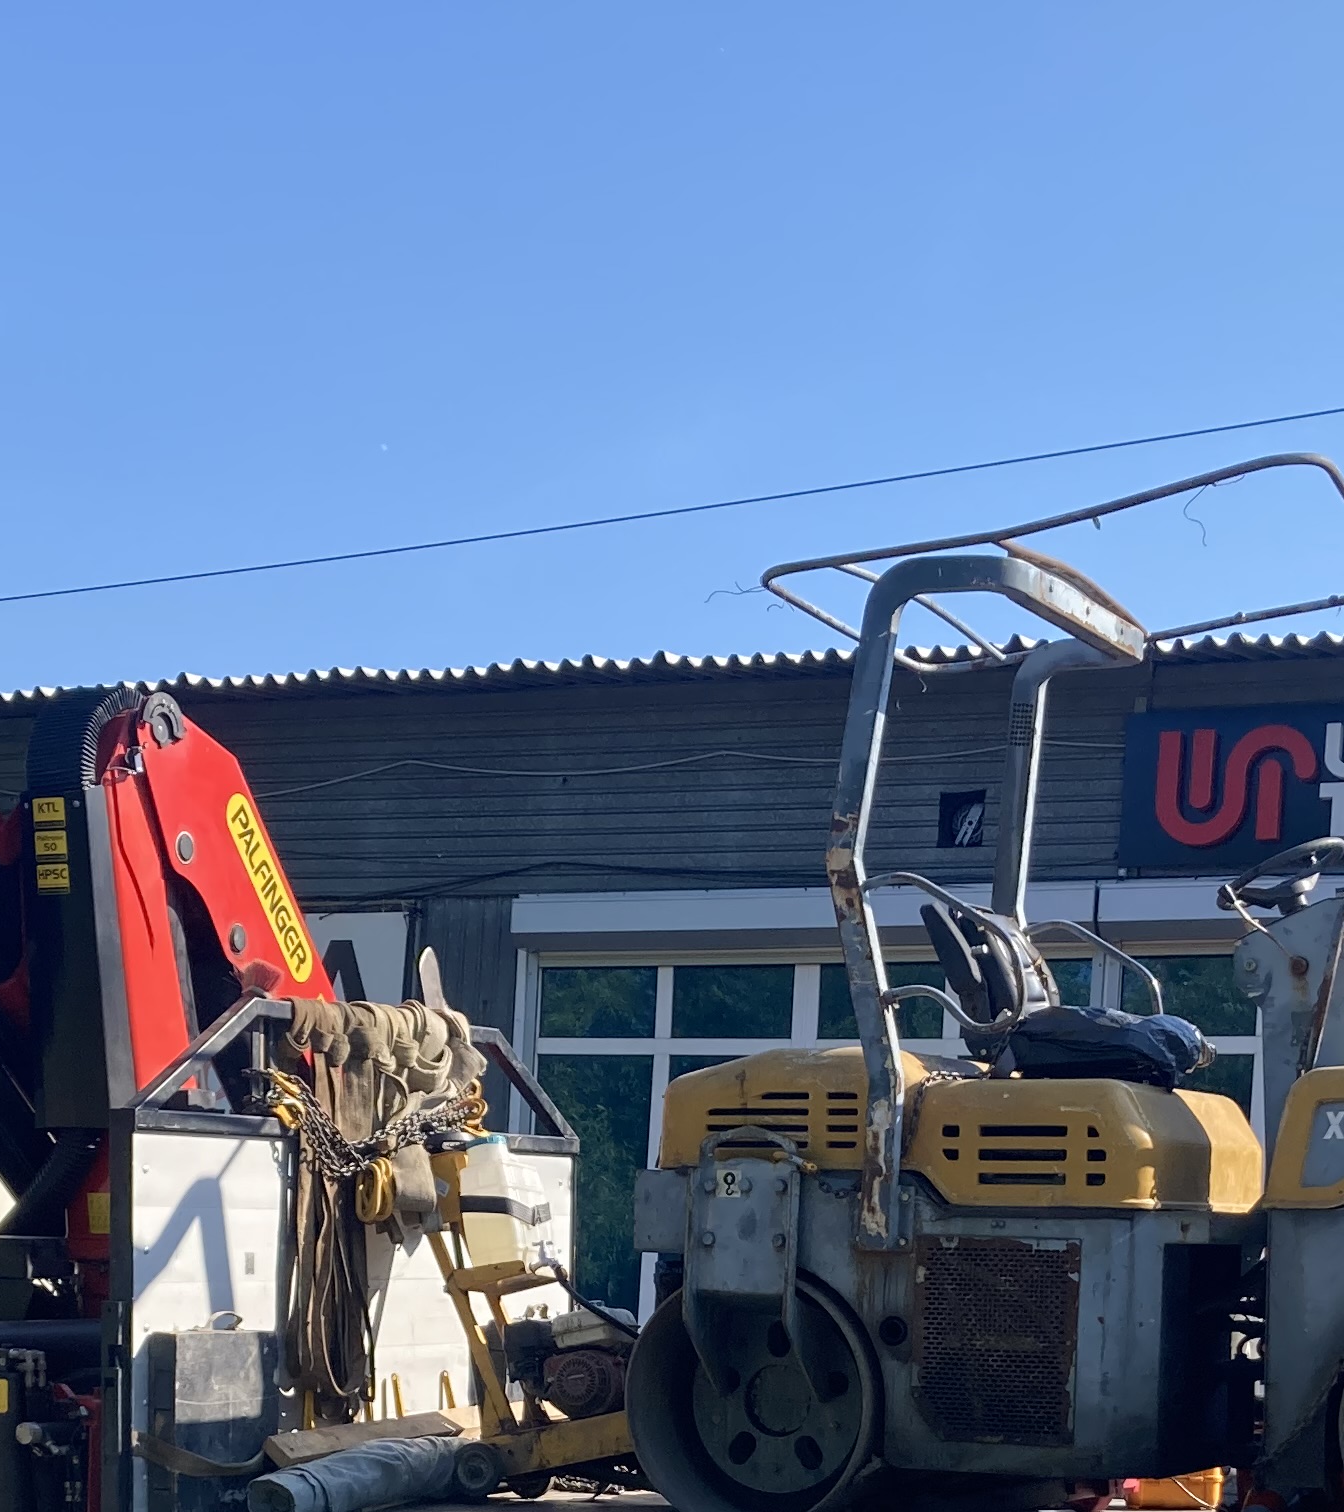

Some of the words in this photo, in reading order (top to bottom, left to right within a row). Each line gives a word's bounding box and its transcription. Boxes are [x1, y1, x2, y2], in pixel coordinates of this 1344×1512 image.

[37, 802, 60, 814] KTL
[38, 868, 68, 880] HPSC
[231, 803, 307, 974] PALFINGER
